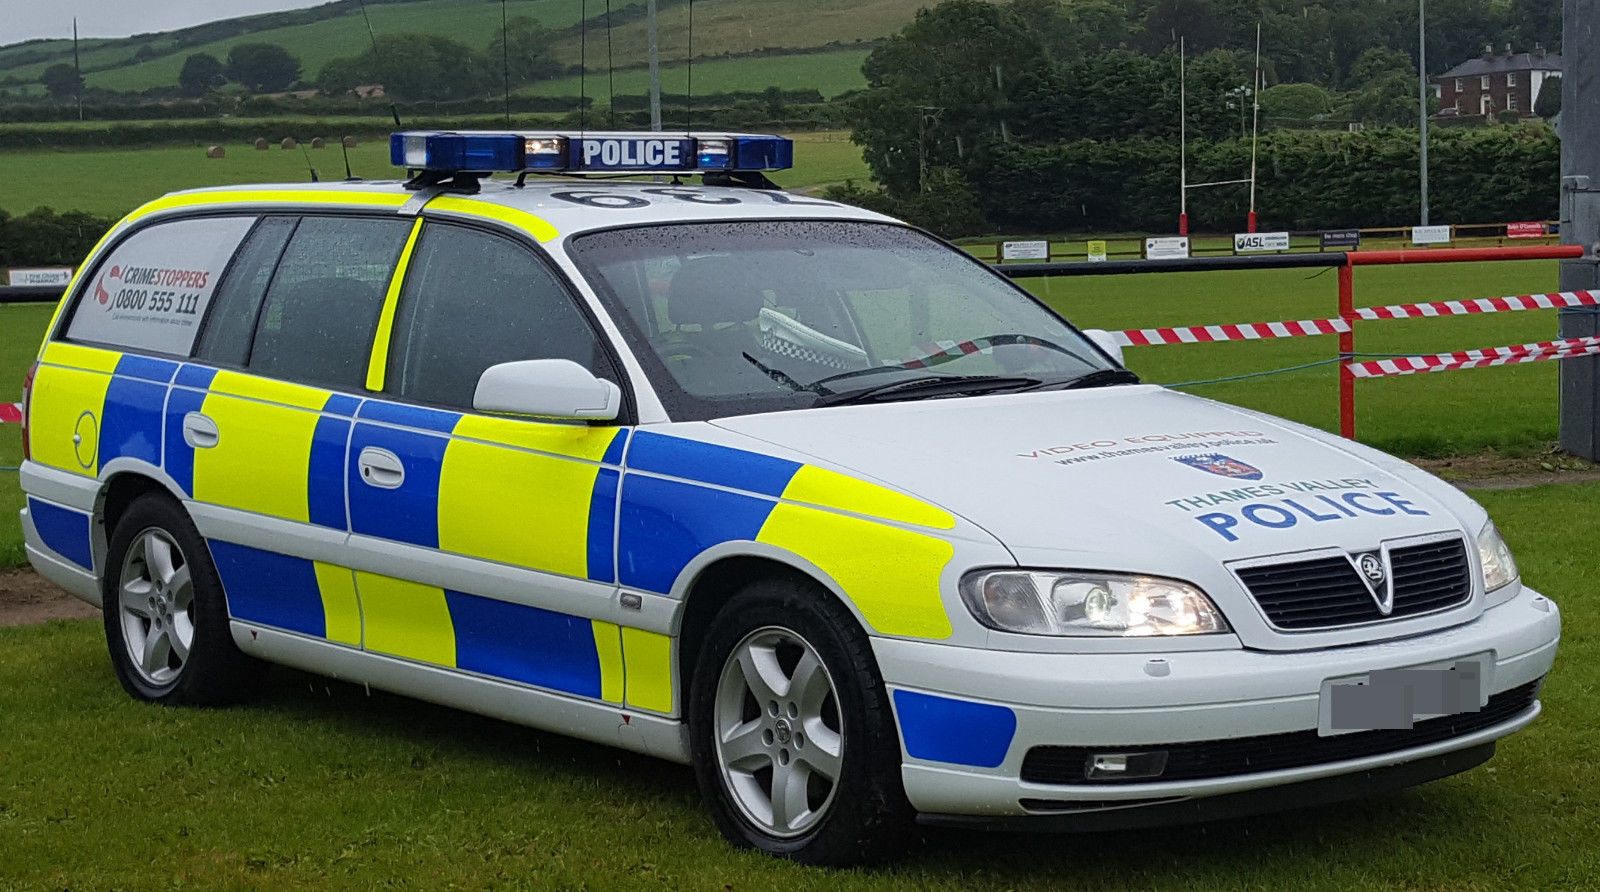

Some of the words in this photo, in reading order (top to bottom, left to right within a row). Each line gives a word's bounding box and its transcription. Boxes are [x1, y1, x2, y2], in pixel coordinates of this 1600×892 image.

[582, 140, 681, 166] POLICE
[1245, 237, 1264, 248] ASL
[124, 266, 210, 289] CRIMESTOPPERS
[116, 289, 148, 311] 0800
[149, 291, 175, 313] 555
[175, 293, 200, 315] 111
[1016, 439, 1118, 459] VIDEO
[1123, 430, 1265, 445] EQUIPPED
[1164, 484, 1287, 512] THAMES
[1279, 478, 1381, 493] VALLEY
[1194, 491, 1432, 543] POLICE
